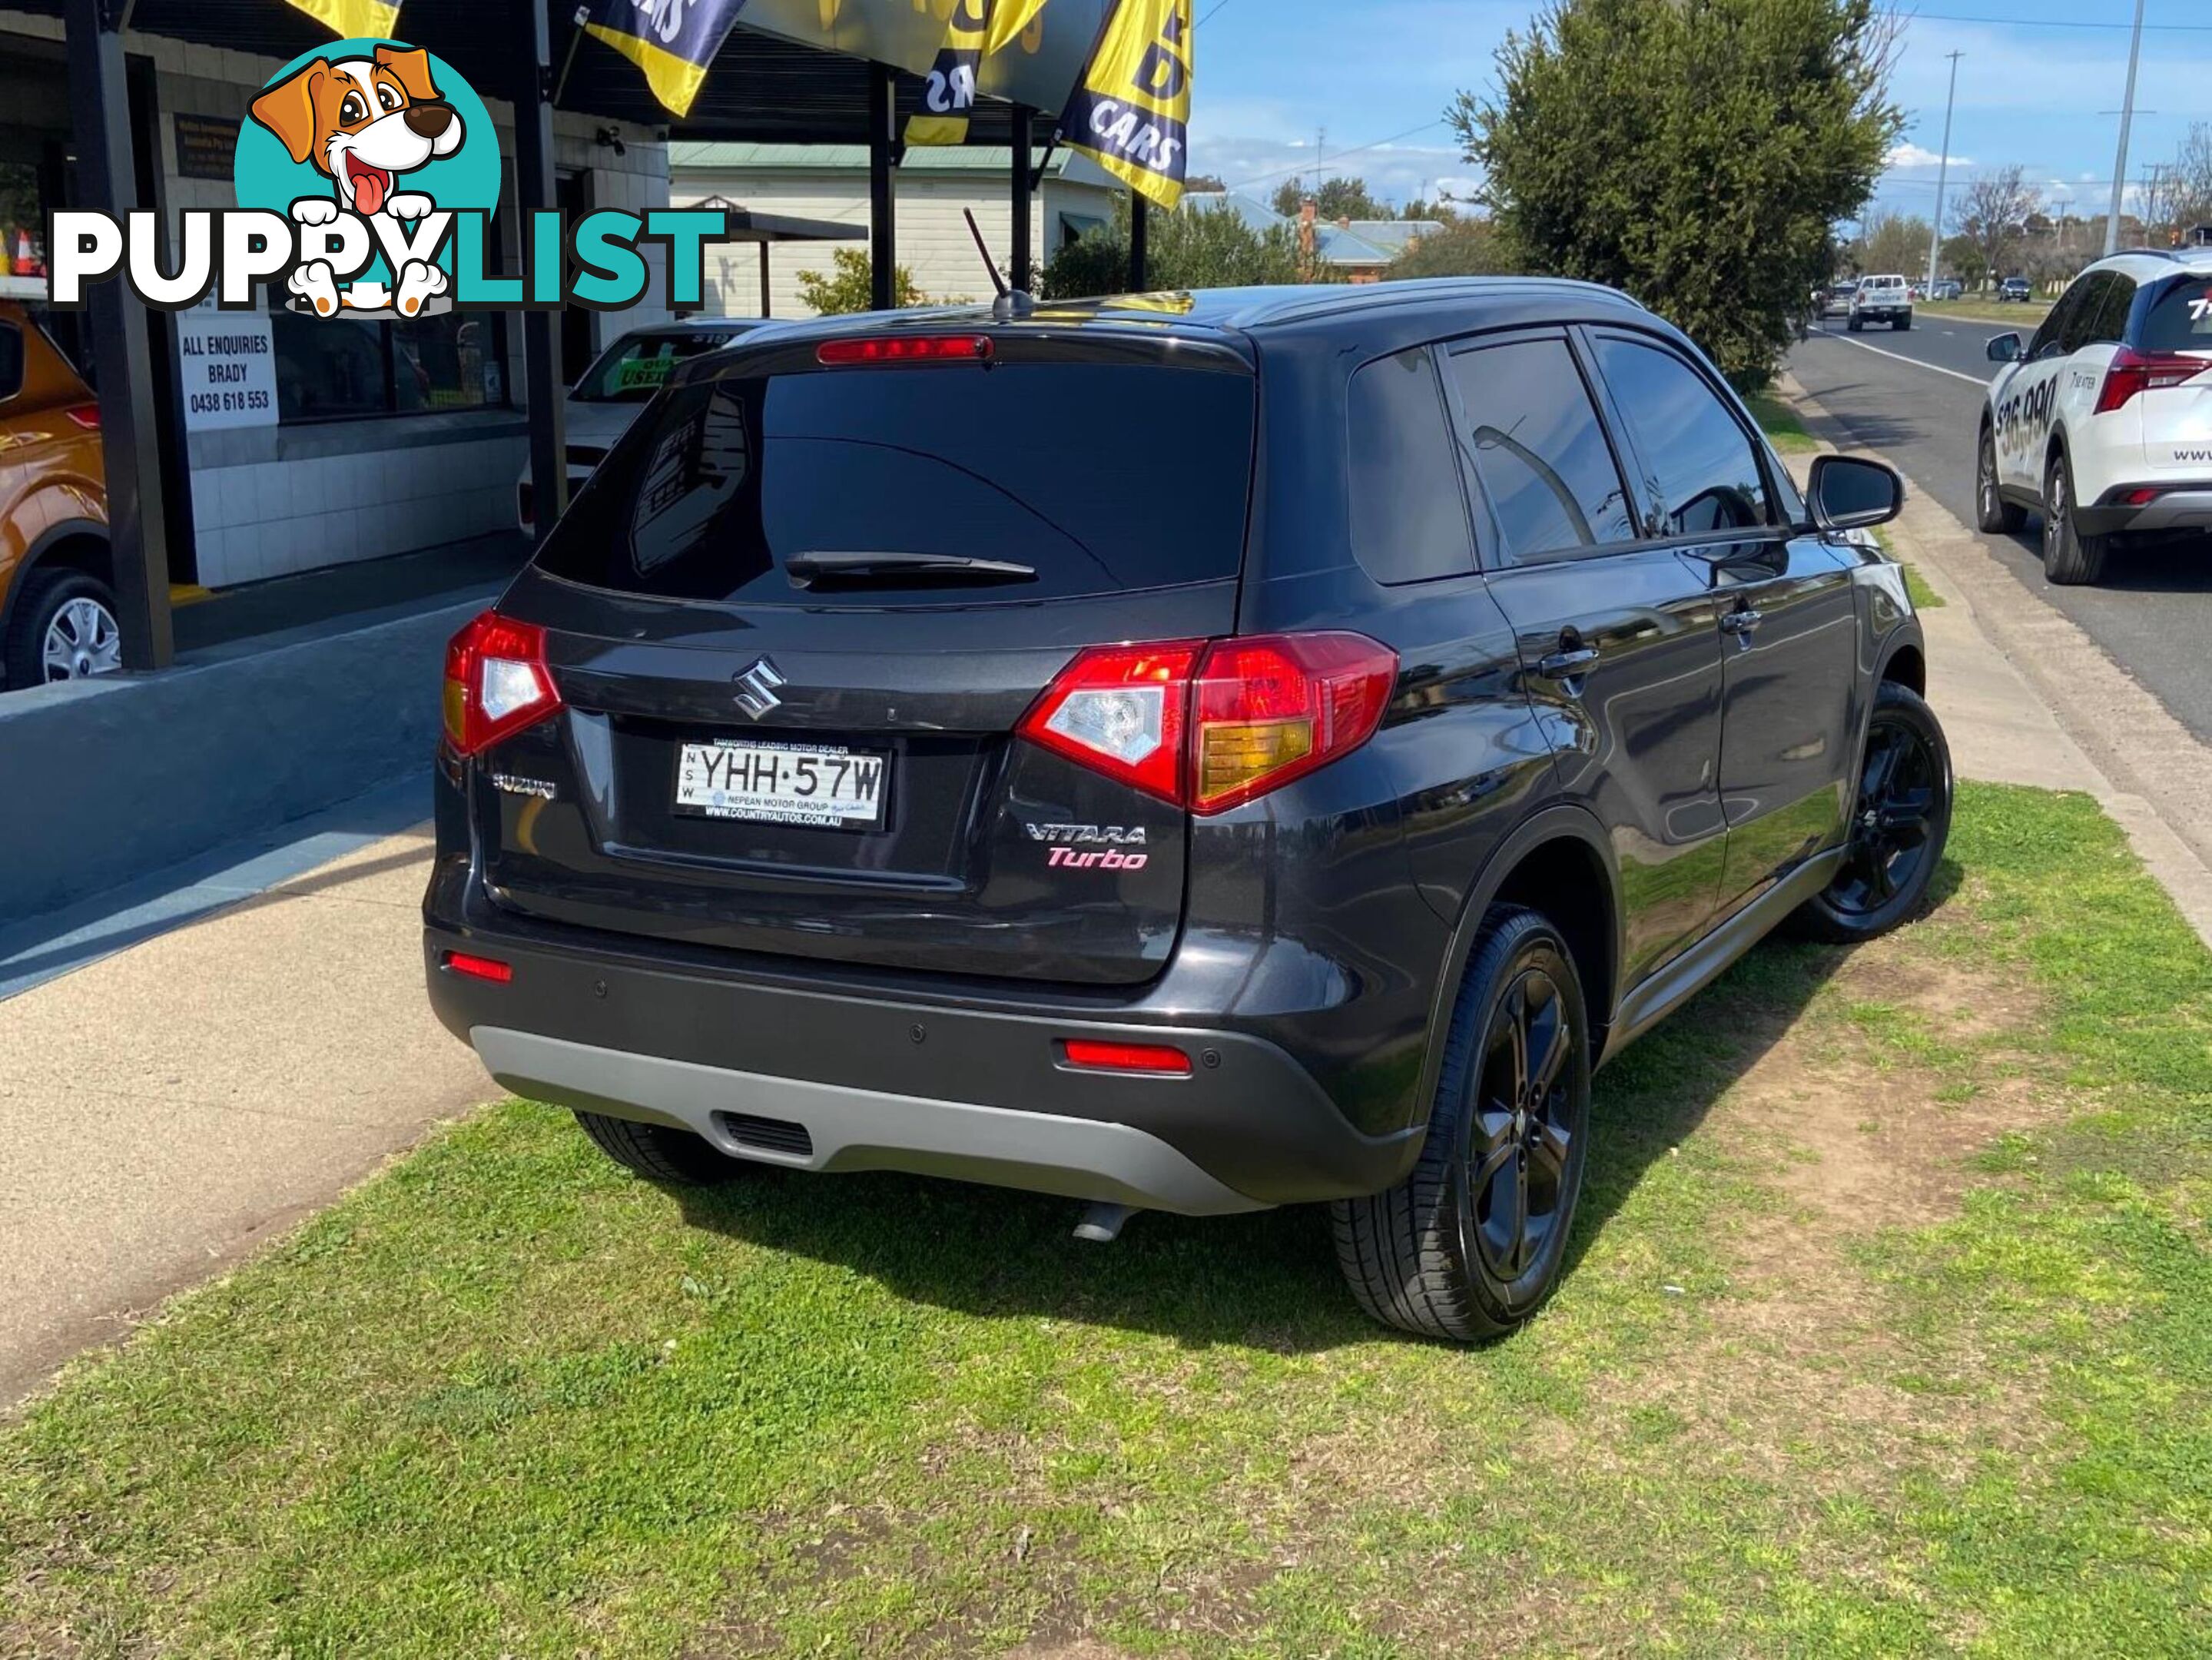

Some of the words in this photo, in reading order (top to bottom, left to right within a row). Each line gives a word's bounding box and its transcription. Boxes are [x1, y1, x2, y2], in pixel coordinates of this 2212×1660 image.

[1089, 101, 1181, 171] CARS
[183, 336, 205, 356] ALL
[207, 334, 268, 357] ENQUIRIES
[208, 364, 247, 383] BRADY
[191, 393, 221, 413] 0438
[224, 392, 245, 410] 618
[248, 390, 269, 409] 553
[790, 743, 817, 753] MOTOR
[818, 745, 848, 755] DEALER
[728, 796, 761, 807] NEPEAN
[764, 798, 795, 808] MOTOR
[798, 802, 828, 812] GROUP
[1026, 823, 1146, 845] VITARA
[1048, 847, 1148, 869] Turbo
